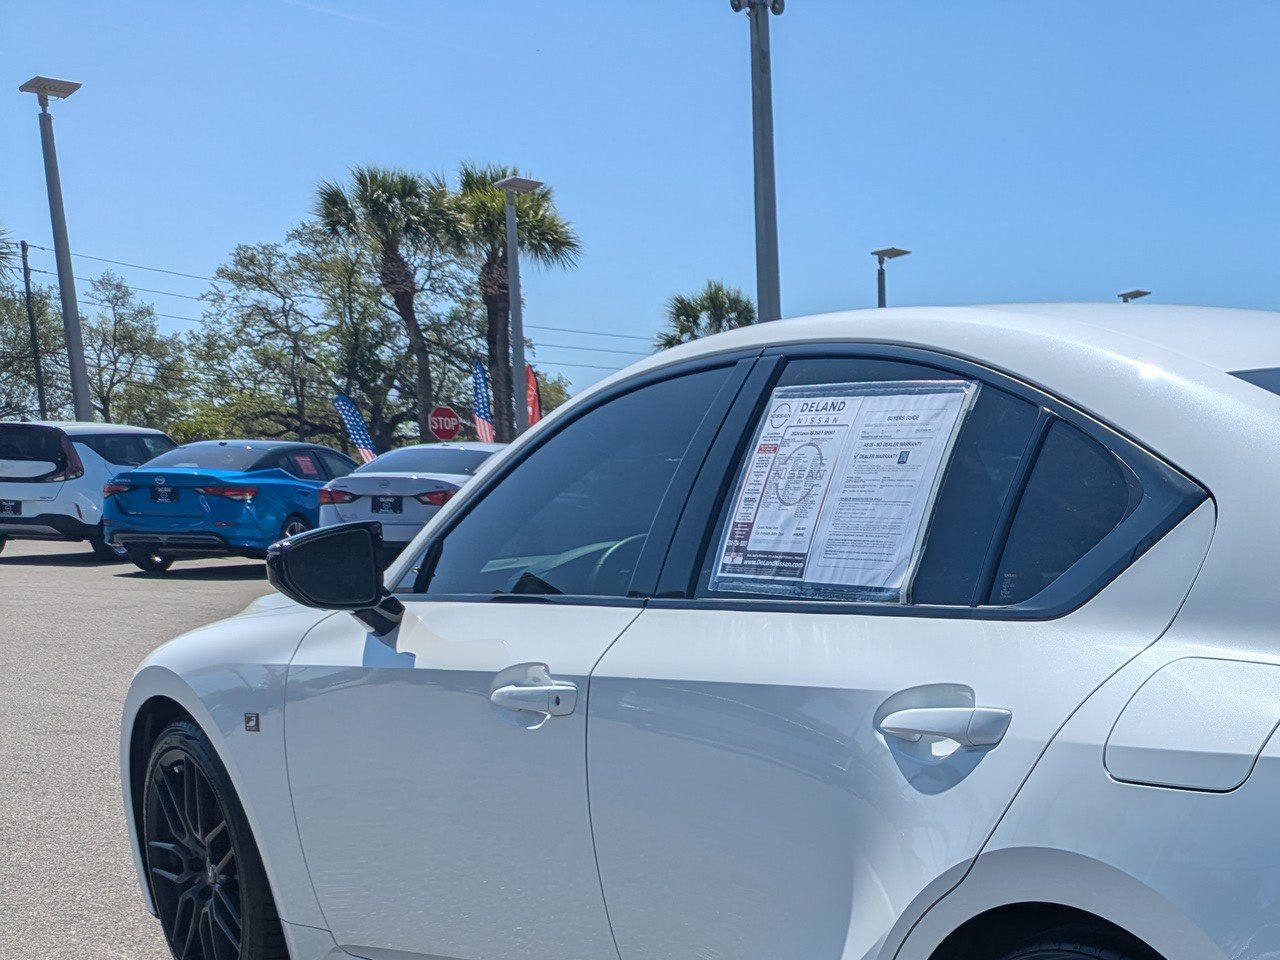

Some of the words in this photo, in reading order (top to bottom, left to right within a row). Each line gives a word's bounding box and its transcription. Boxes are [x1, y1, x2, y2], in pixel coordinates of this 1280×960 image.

[800, 401, 846, 413] DELAND
[431, 416, 458, 431] STOP
[796, 416, 840, 424] NISSAN
